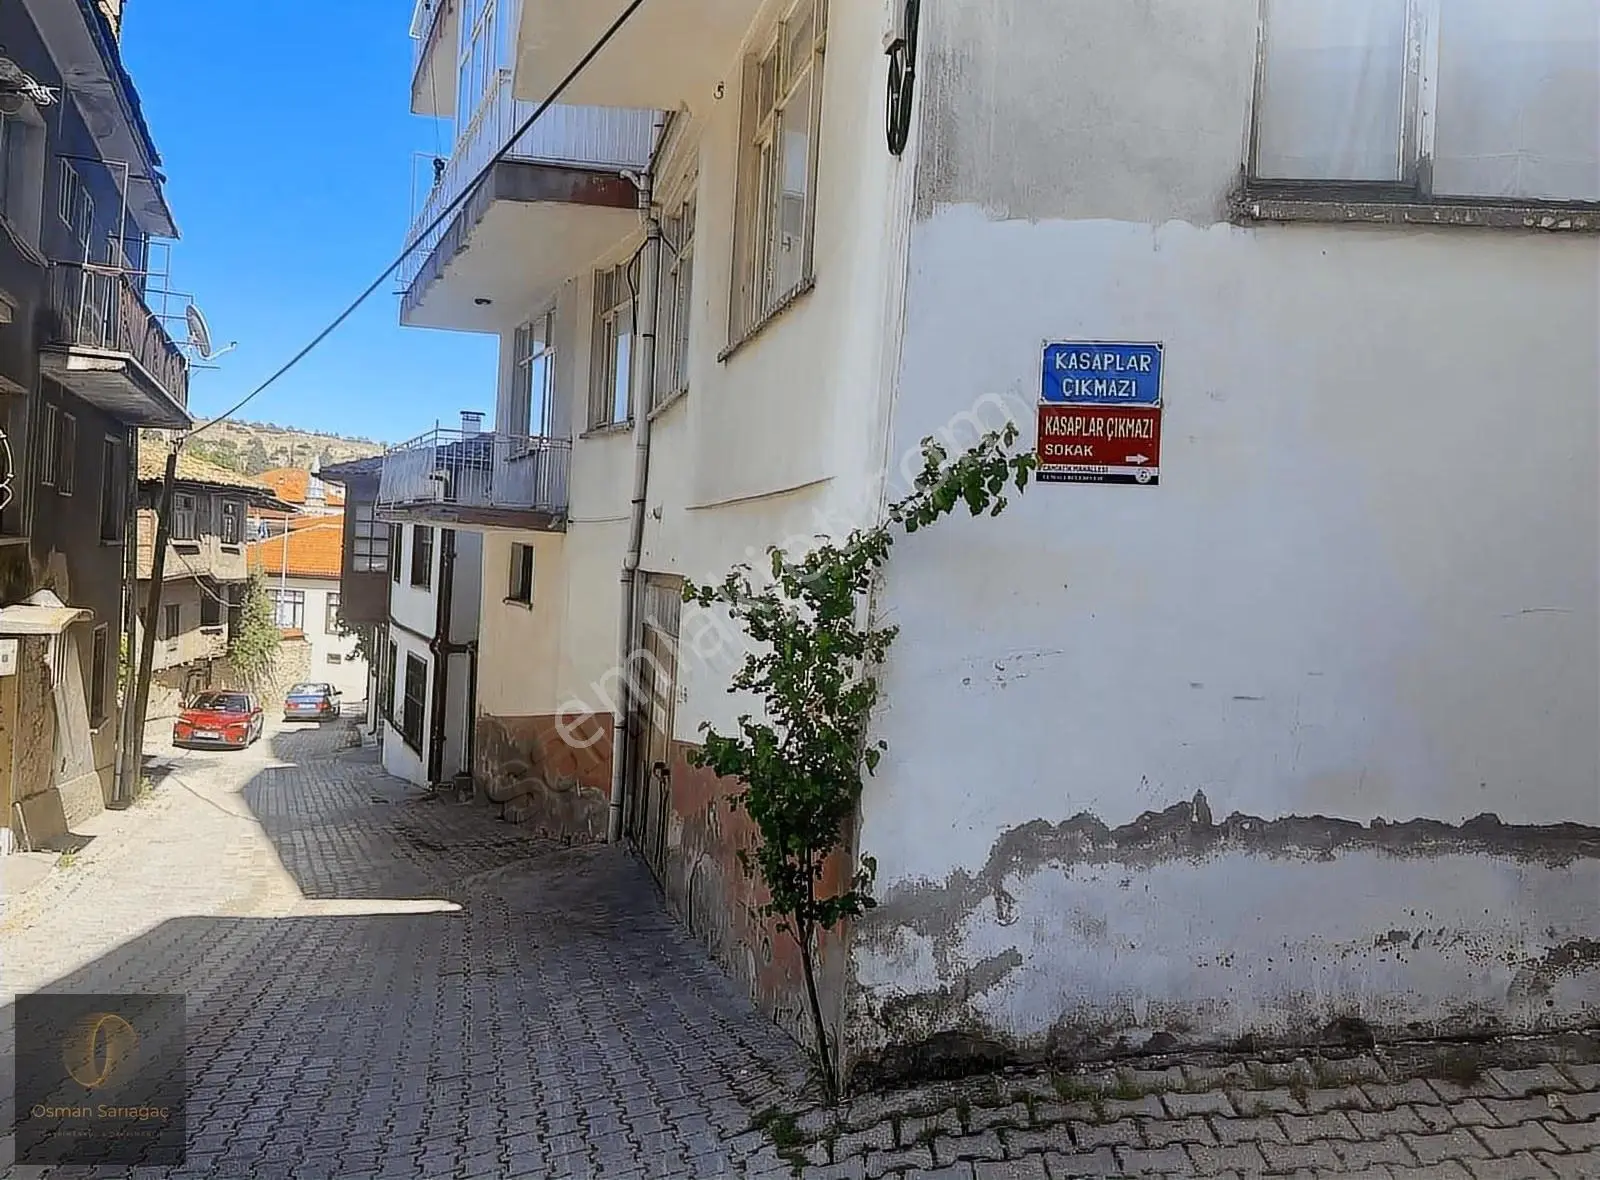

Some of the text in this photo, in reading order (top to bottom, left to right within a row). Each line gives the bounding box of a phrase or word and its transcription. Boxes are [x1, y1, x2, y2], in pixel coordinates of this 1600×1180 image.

[1055, 352, 1151, 372] KASAPLAR
[1062, 378, 1137, 397] ÇIKMAZI
[1045, 416, 1154, 441] KASAPLAR ÇIKMAZI
[1045, 443, 1094, 457] SOKAK
